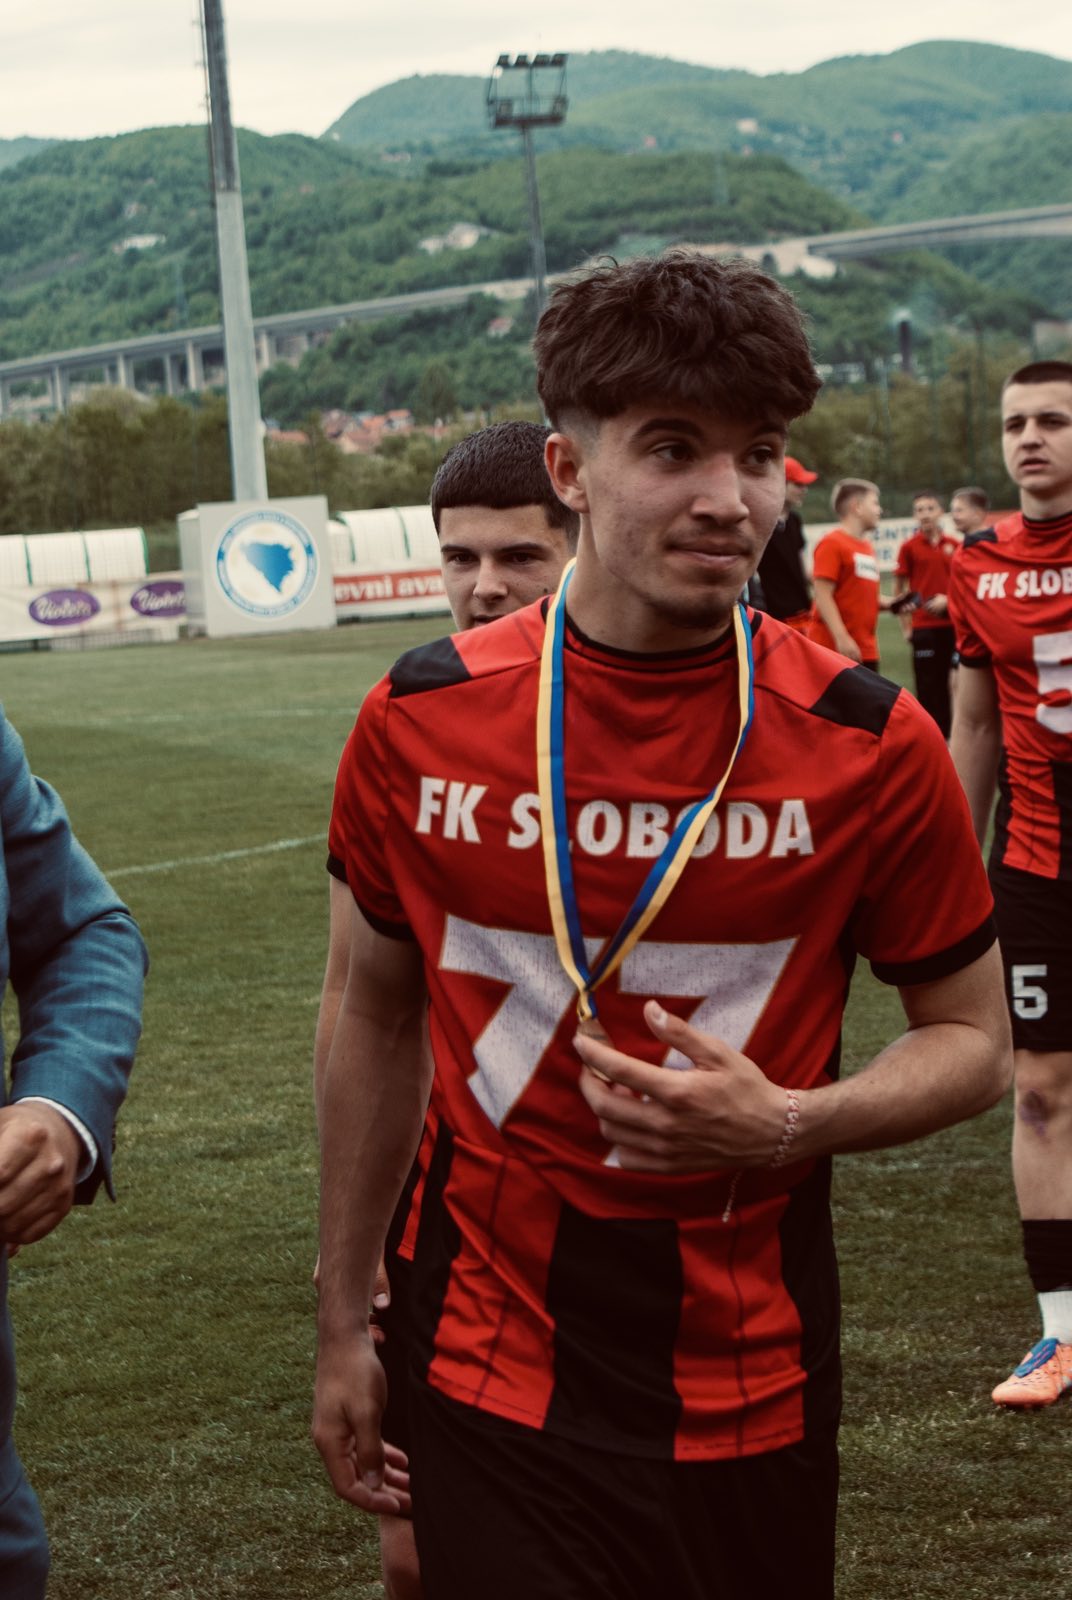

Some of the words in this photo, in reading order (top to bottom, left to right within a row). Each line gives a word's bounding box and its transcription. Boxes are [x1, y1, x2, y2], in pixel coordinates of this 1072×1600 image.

[976, 572, 1009, 600] FK
[415, 775, 489, 844] FK
[507, 791, 815, 860] SOBODA
[1012, 964, 1047, 1019] 5
[438, 912, 800, 1168] 77
